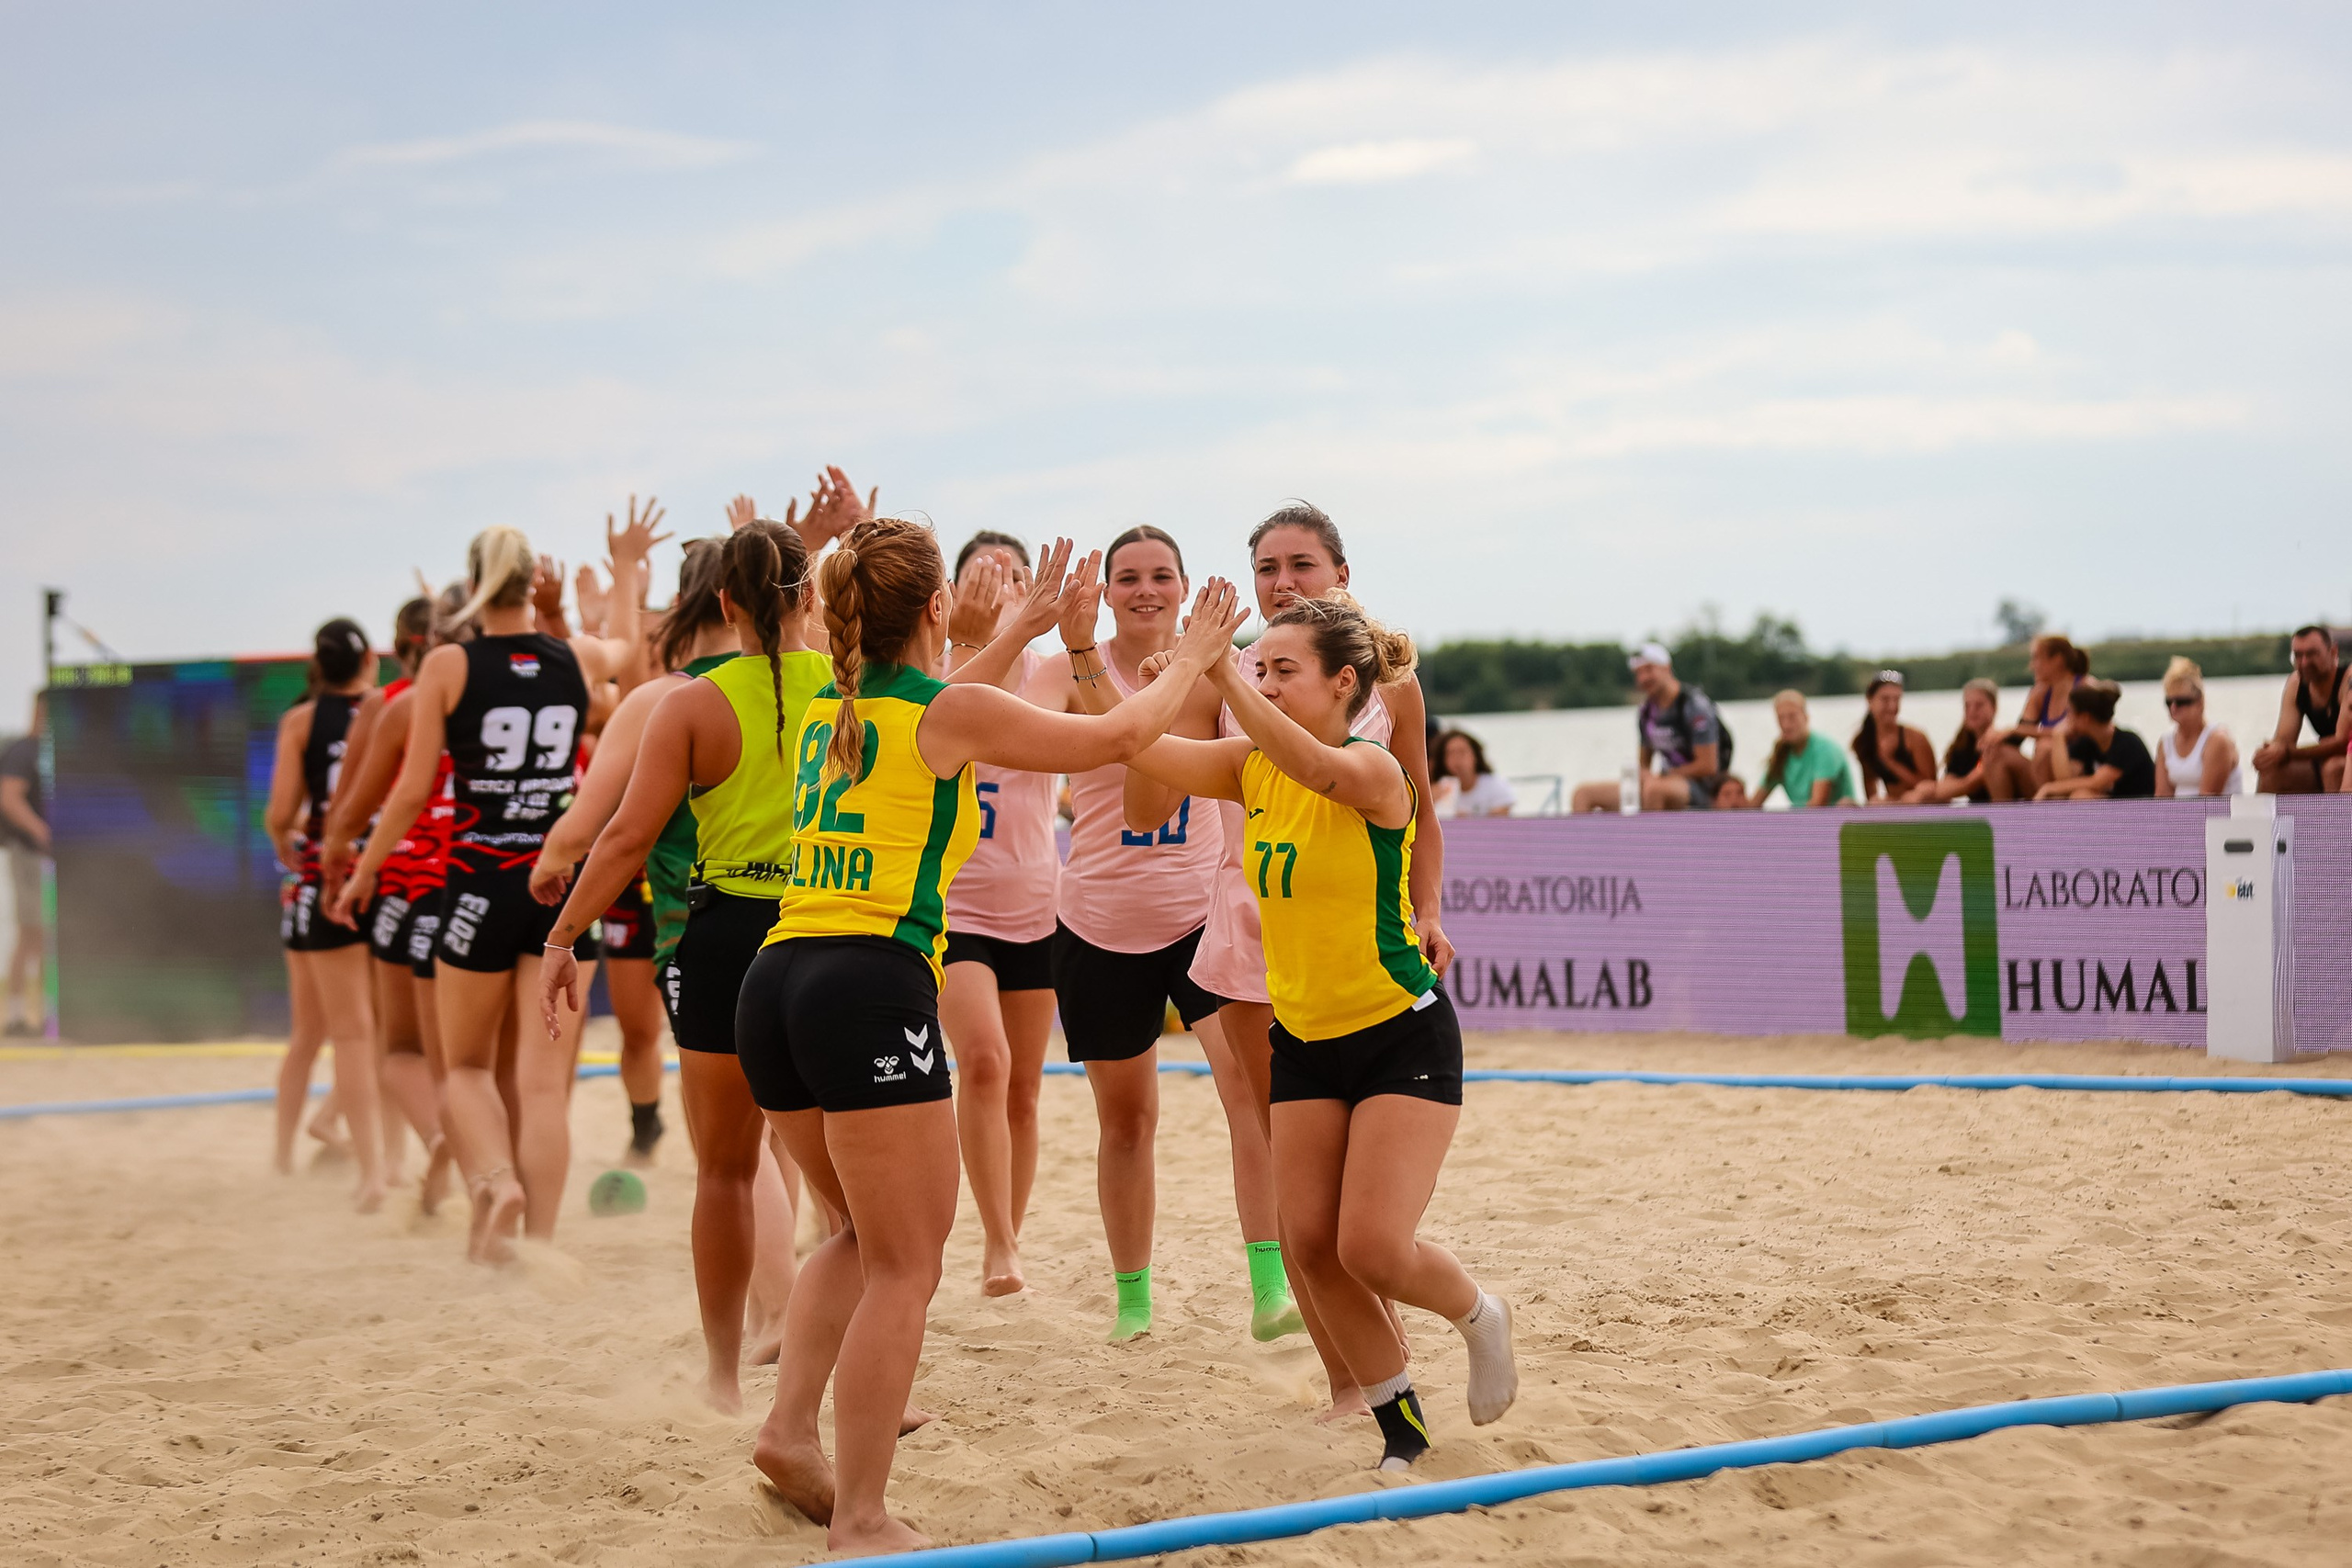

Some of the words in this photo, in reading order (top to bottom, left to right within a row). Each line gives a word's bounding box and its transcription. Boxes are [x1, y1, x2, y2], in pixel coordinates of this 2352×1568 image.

[480, 705, 579, 773] 99
[793, 719, 880, 834] 82
[1254, 840, 1298, 899] 77
[2004, 865, 2207, 909] LABORATO
[2006, 957, 2207, 1012] HUMAL
[874, 1071, 907, 1083] hummel
